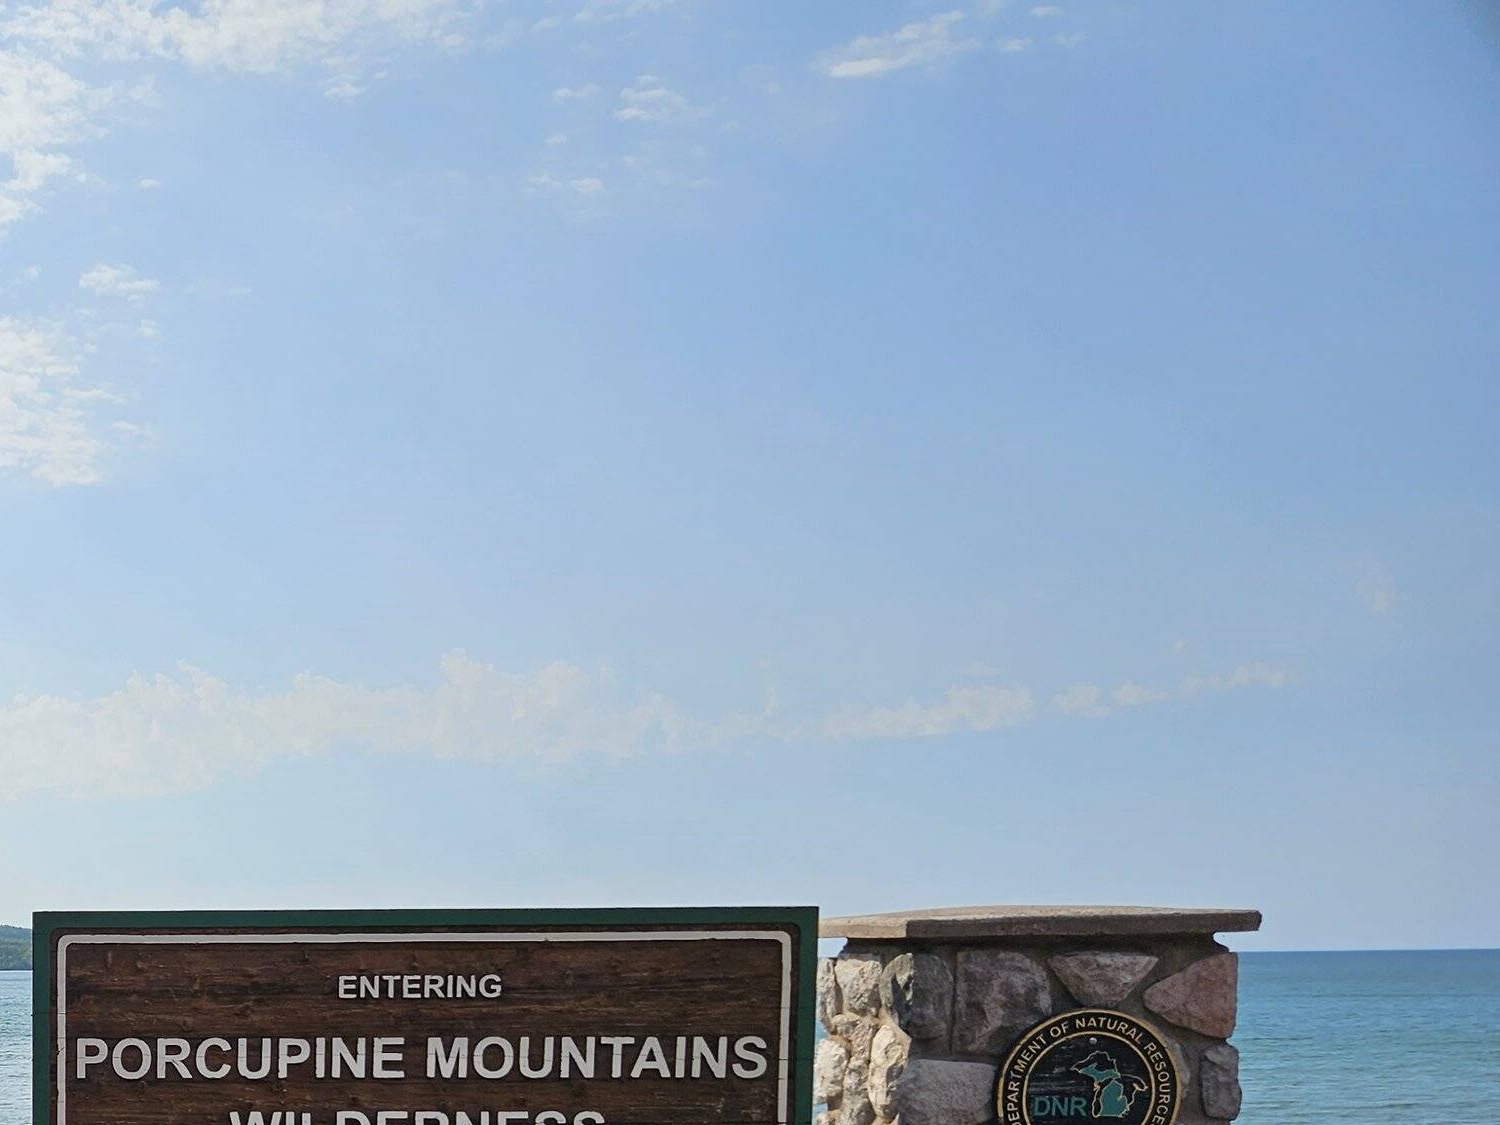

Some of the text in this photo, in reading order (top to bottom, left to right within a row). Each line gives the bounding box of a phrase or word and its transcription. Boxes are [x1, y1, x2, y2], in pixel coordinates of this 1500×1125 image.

[337, 973, 502, 1001] ENTERING
[1050, 1021, 1070, 1038] OF
[1075, 1017, 1144, 1044] NATURAL
[75, 1035, 768, 1080] PORCUPINE MOUNTAINS
[1033, 1097, 1087, 1117] DNR
